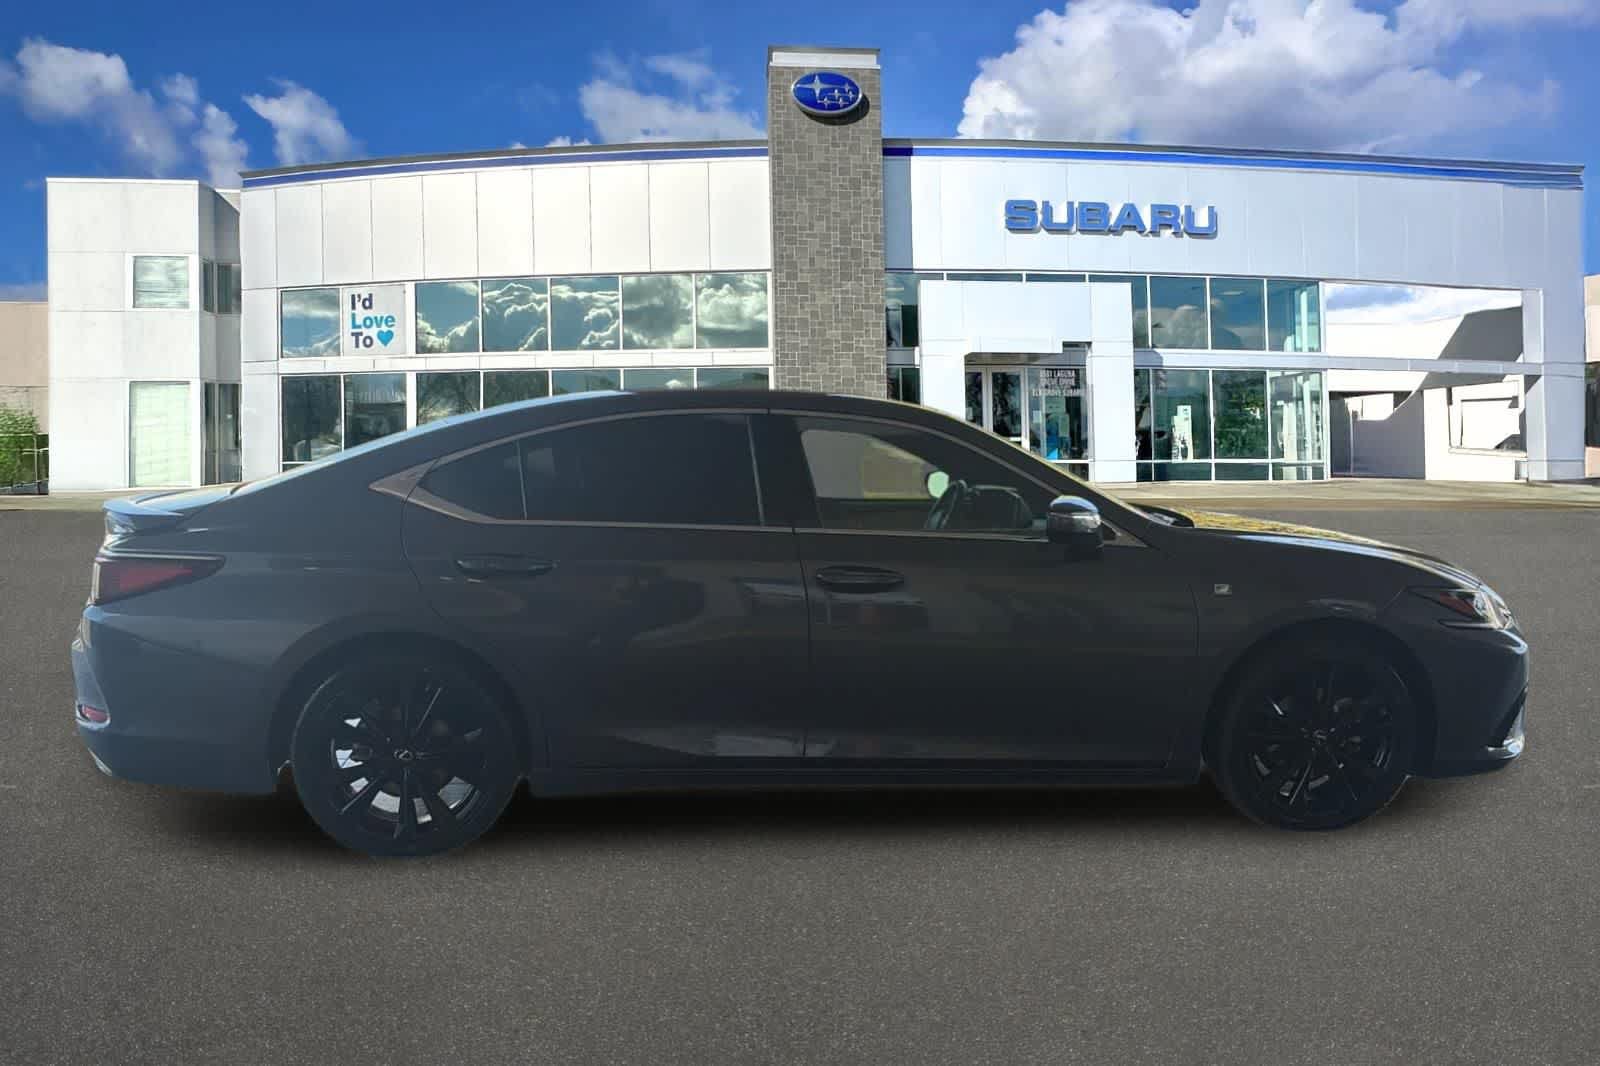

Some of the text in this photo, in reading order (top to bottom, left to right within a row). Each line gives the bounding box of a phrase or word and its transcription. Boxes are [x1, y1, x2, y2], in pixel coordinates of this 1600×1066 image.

[1005, 199, 1217, 238] SUBARU
[351, 293, 373, 310] I'd
[351, 312, 396, 329] Love
[351, 331, 374, 348] To
